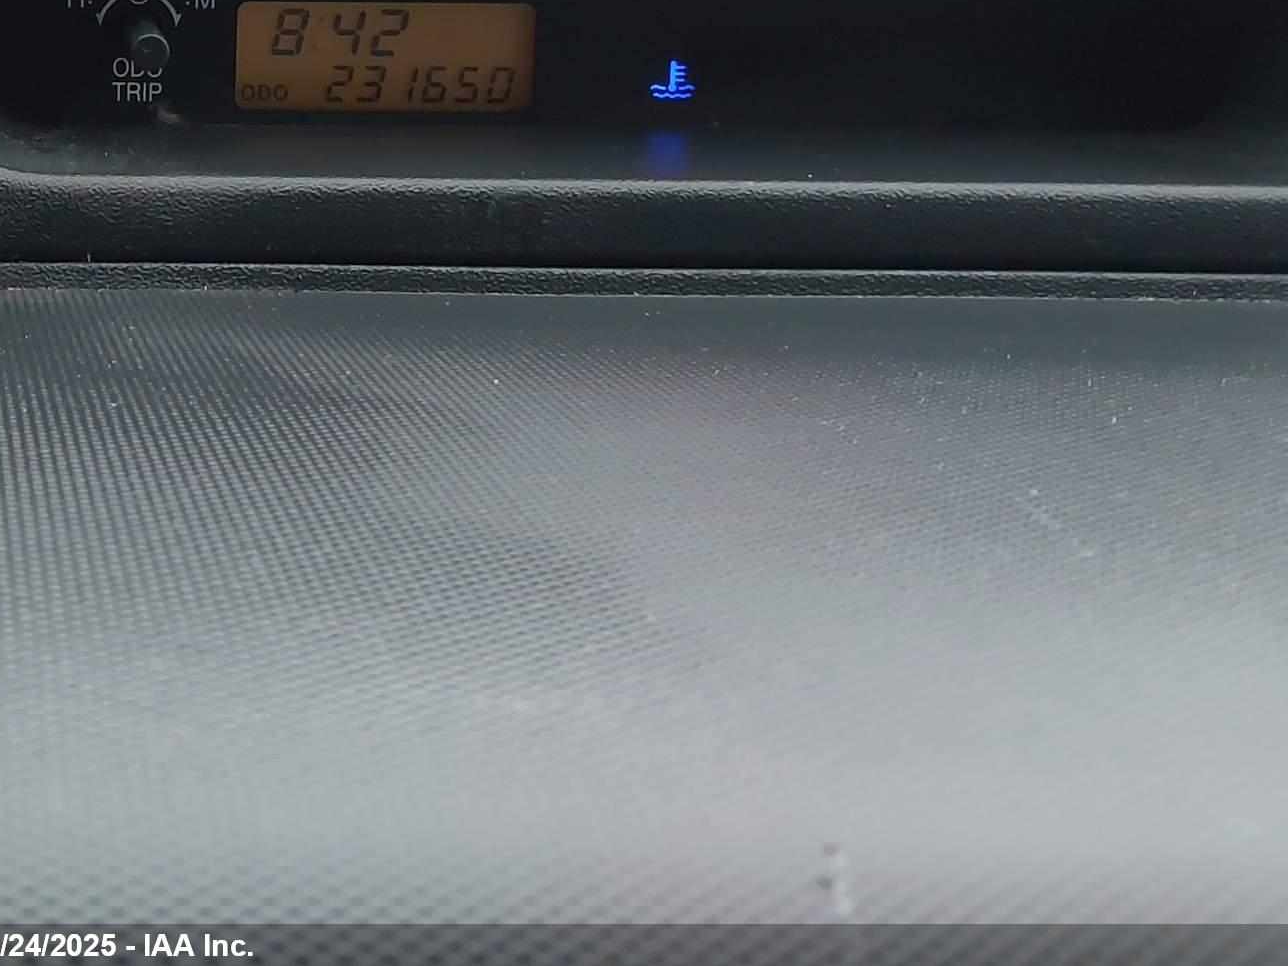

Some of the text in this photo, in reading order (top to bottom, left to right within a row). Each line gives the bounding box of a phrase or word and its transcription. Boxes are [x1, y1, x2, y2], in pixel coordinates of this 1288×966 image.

[112, 82, 162, 102] TRIP
[241, 65, 515, 103] ODO 231650
